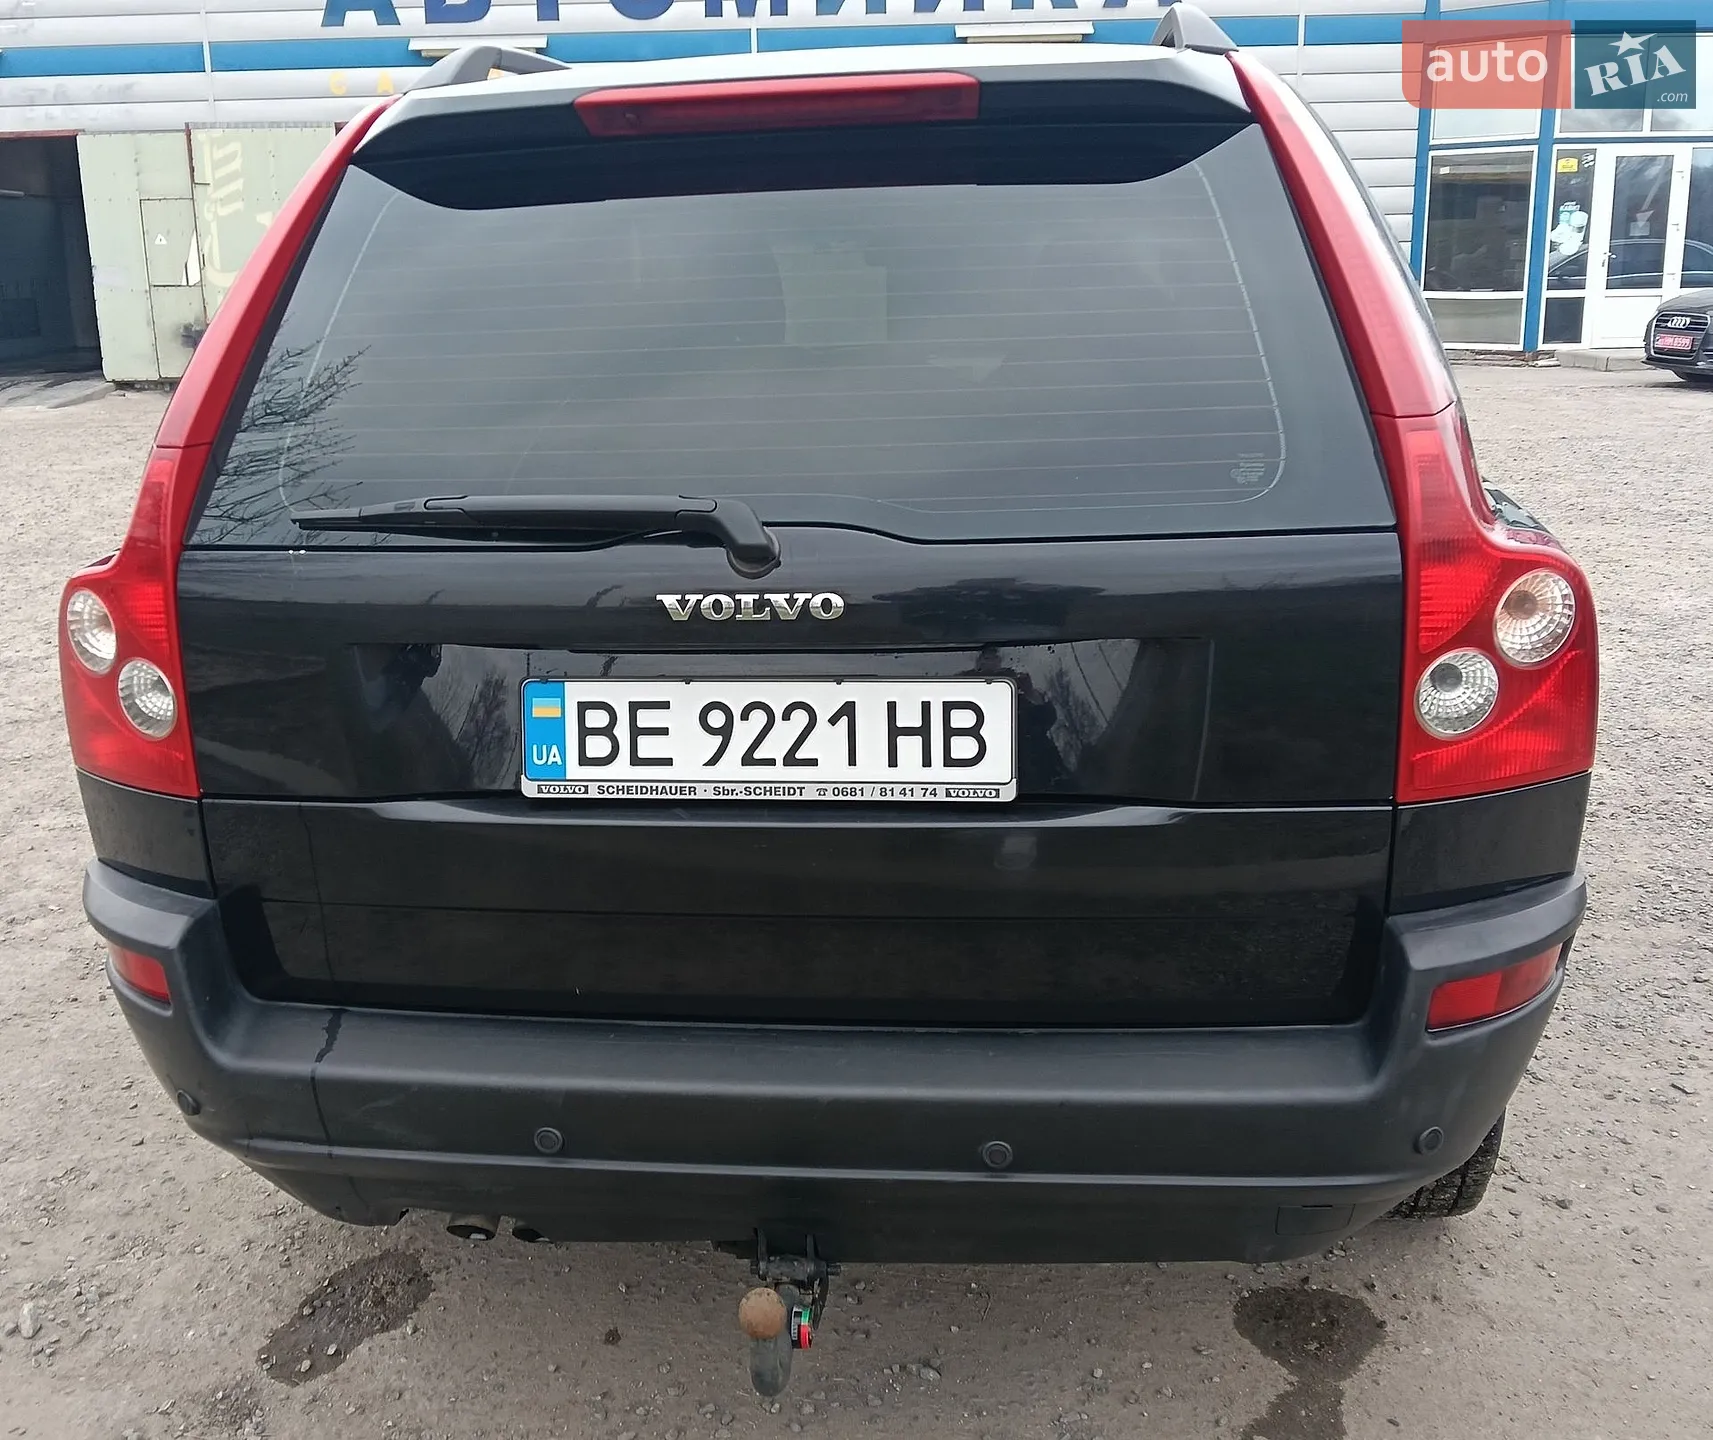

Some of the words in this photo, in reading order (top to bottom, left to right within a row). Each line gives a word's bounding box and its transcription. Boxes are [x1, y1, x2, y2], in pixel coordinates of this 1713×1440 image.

[655, 592, 845, 621] VOLVO
[577, 701, 674, 767] BE
[699, 701, 857, 767] 9221
[887, 701, 987, 768] HB
[532, 744, 563, 766] UA
[539, 785, 587, 795] VOLVO
[597, 785, 697, 796] SCHEIDHAUER
[713, 786, 806, 797] Sbr.-SCHEIDT
[832, 786, 865, 797] 0681
[920, 787, 938, 798] 74
[948, 788, 998, 799] VOLVO
